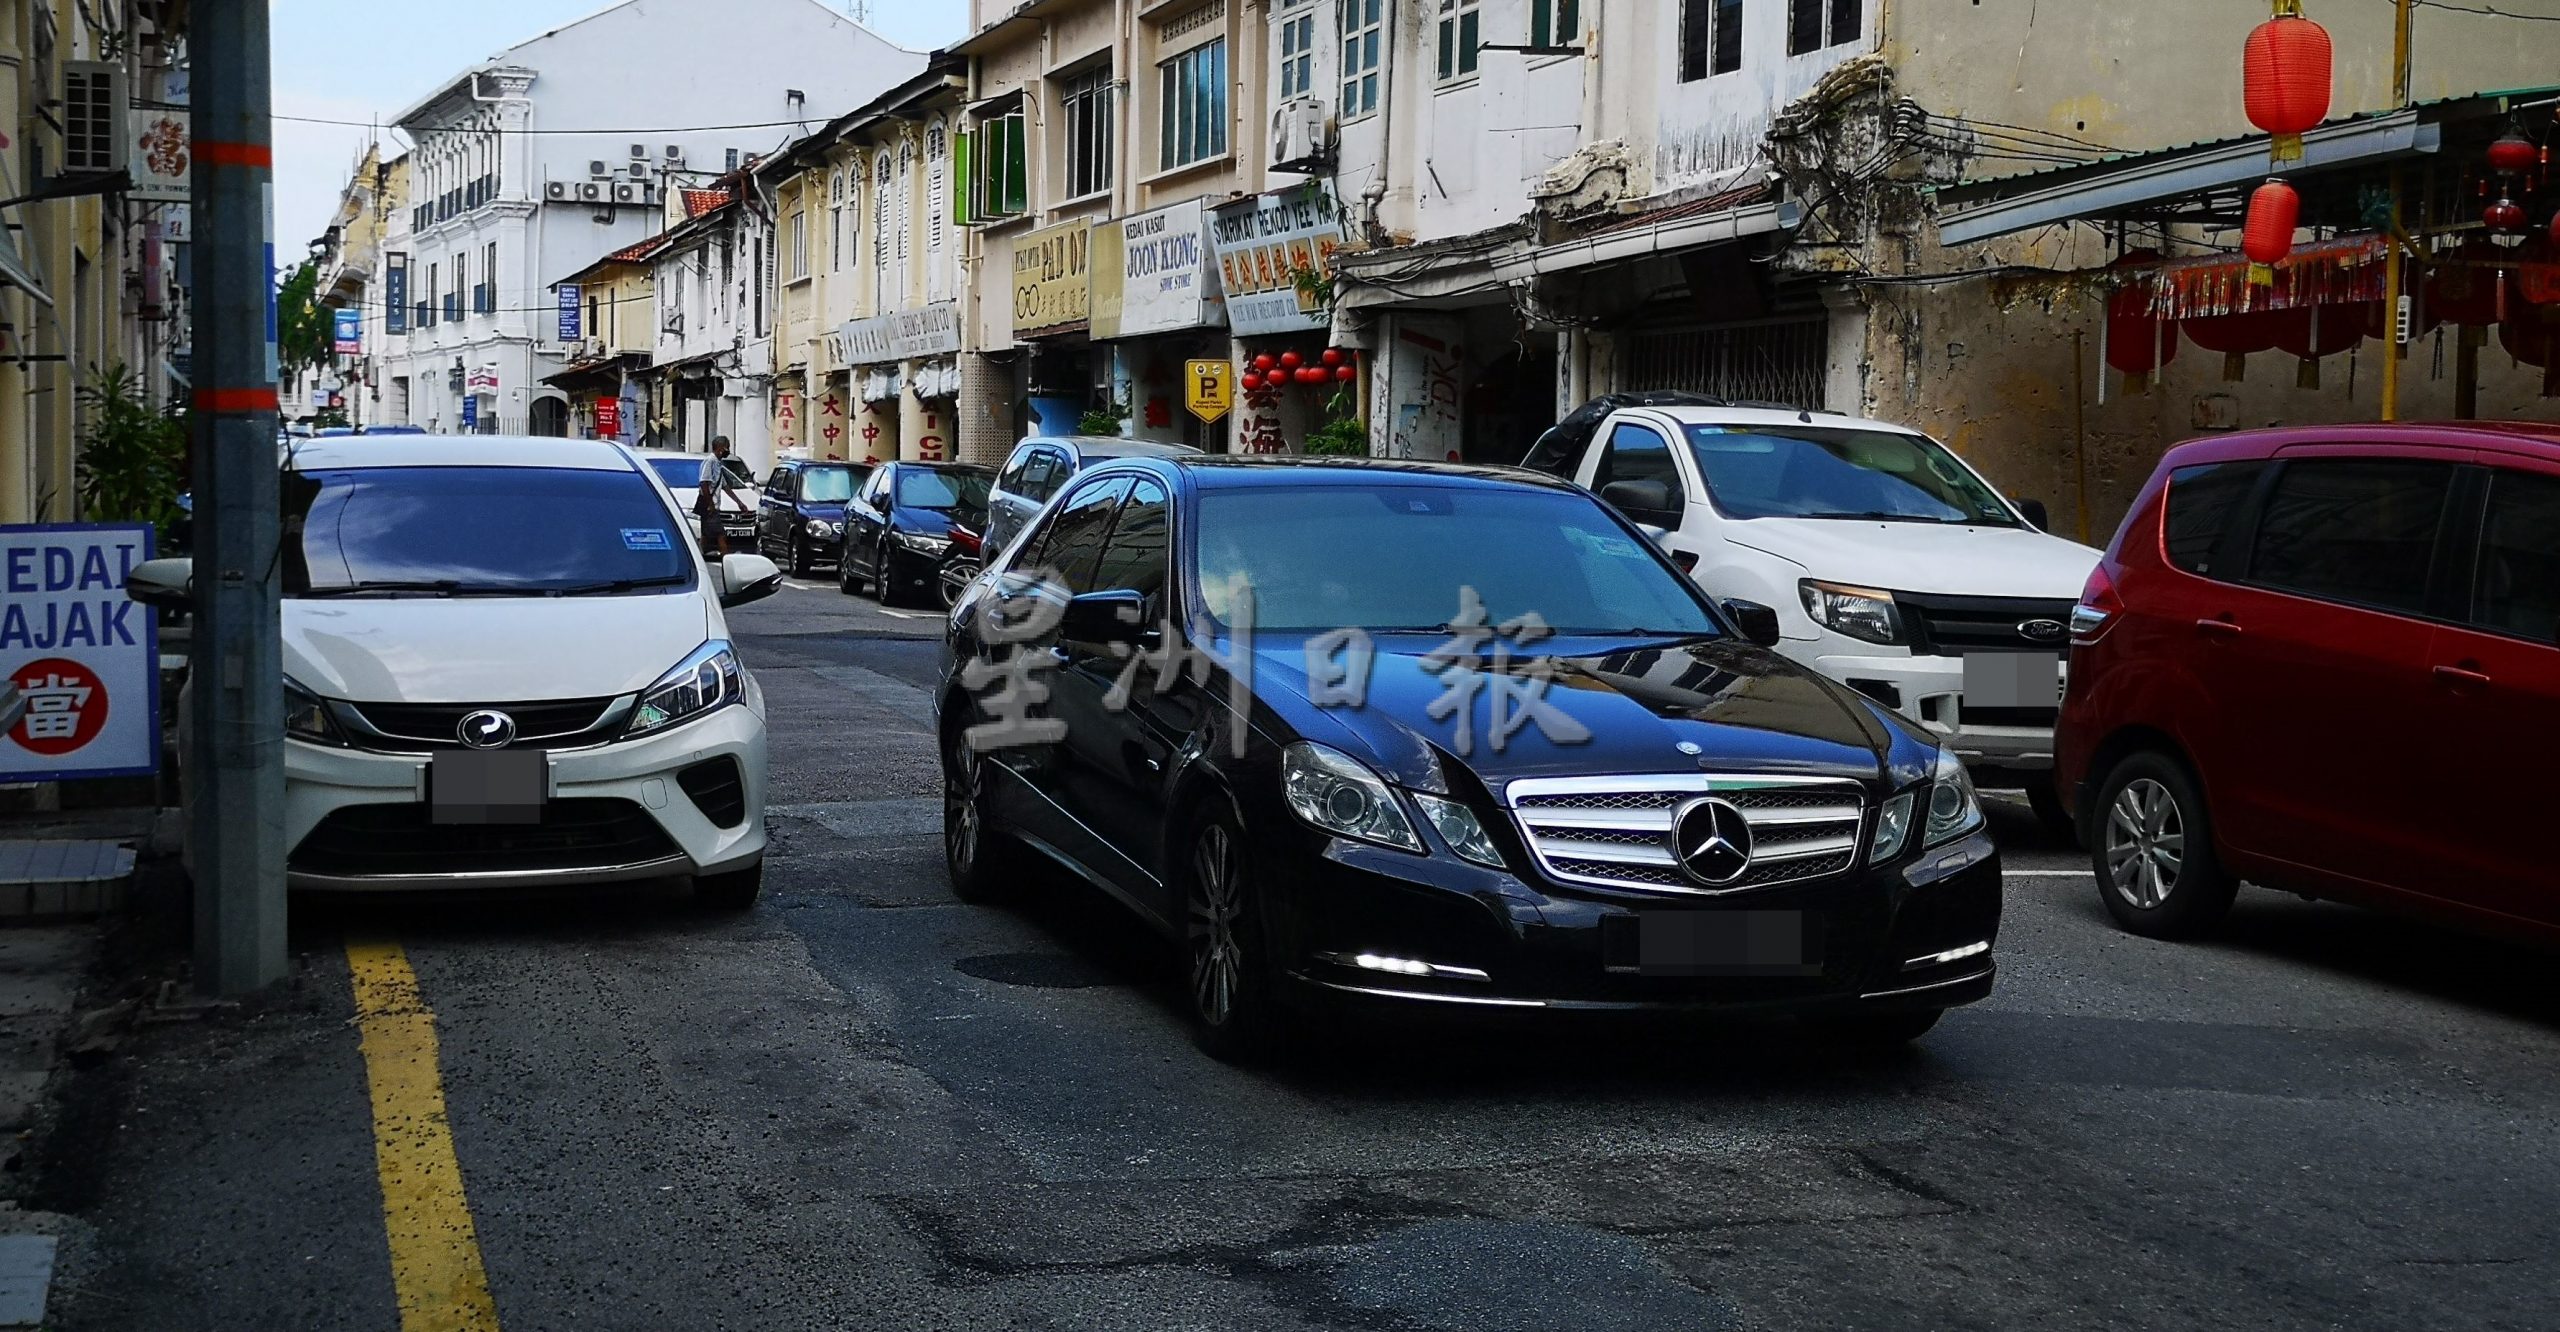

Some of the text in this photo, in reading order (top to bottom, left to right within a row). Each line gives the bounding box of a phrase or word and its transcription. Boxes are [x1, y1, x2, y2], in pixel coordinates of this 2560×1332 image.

[1125, 215, 1165, 240] KEDAI KASUT
[1213, 212, 1255, 245] SYARIKAT
[1257, 204, 1290, 237] REKOD
[1291, 201, 1314, 231] YEE
[1127, 232, 1198, 278] JOON KIONG
[1174, 273, 1192, 290] STORE
[1257, 299, 1286, 321] RECORD
[1201, 377, 1218, 398] P
[0, 544, 135, 593] EDAI
[0, 600, 136, 649] AJAK
[2030, 622, 2060, 636] Ford
[18, 674, 92, 739] 當
